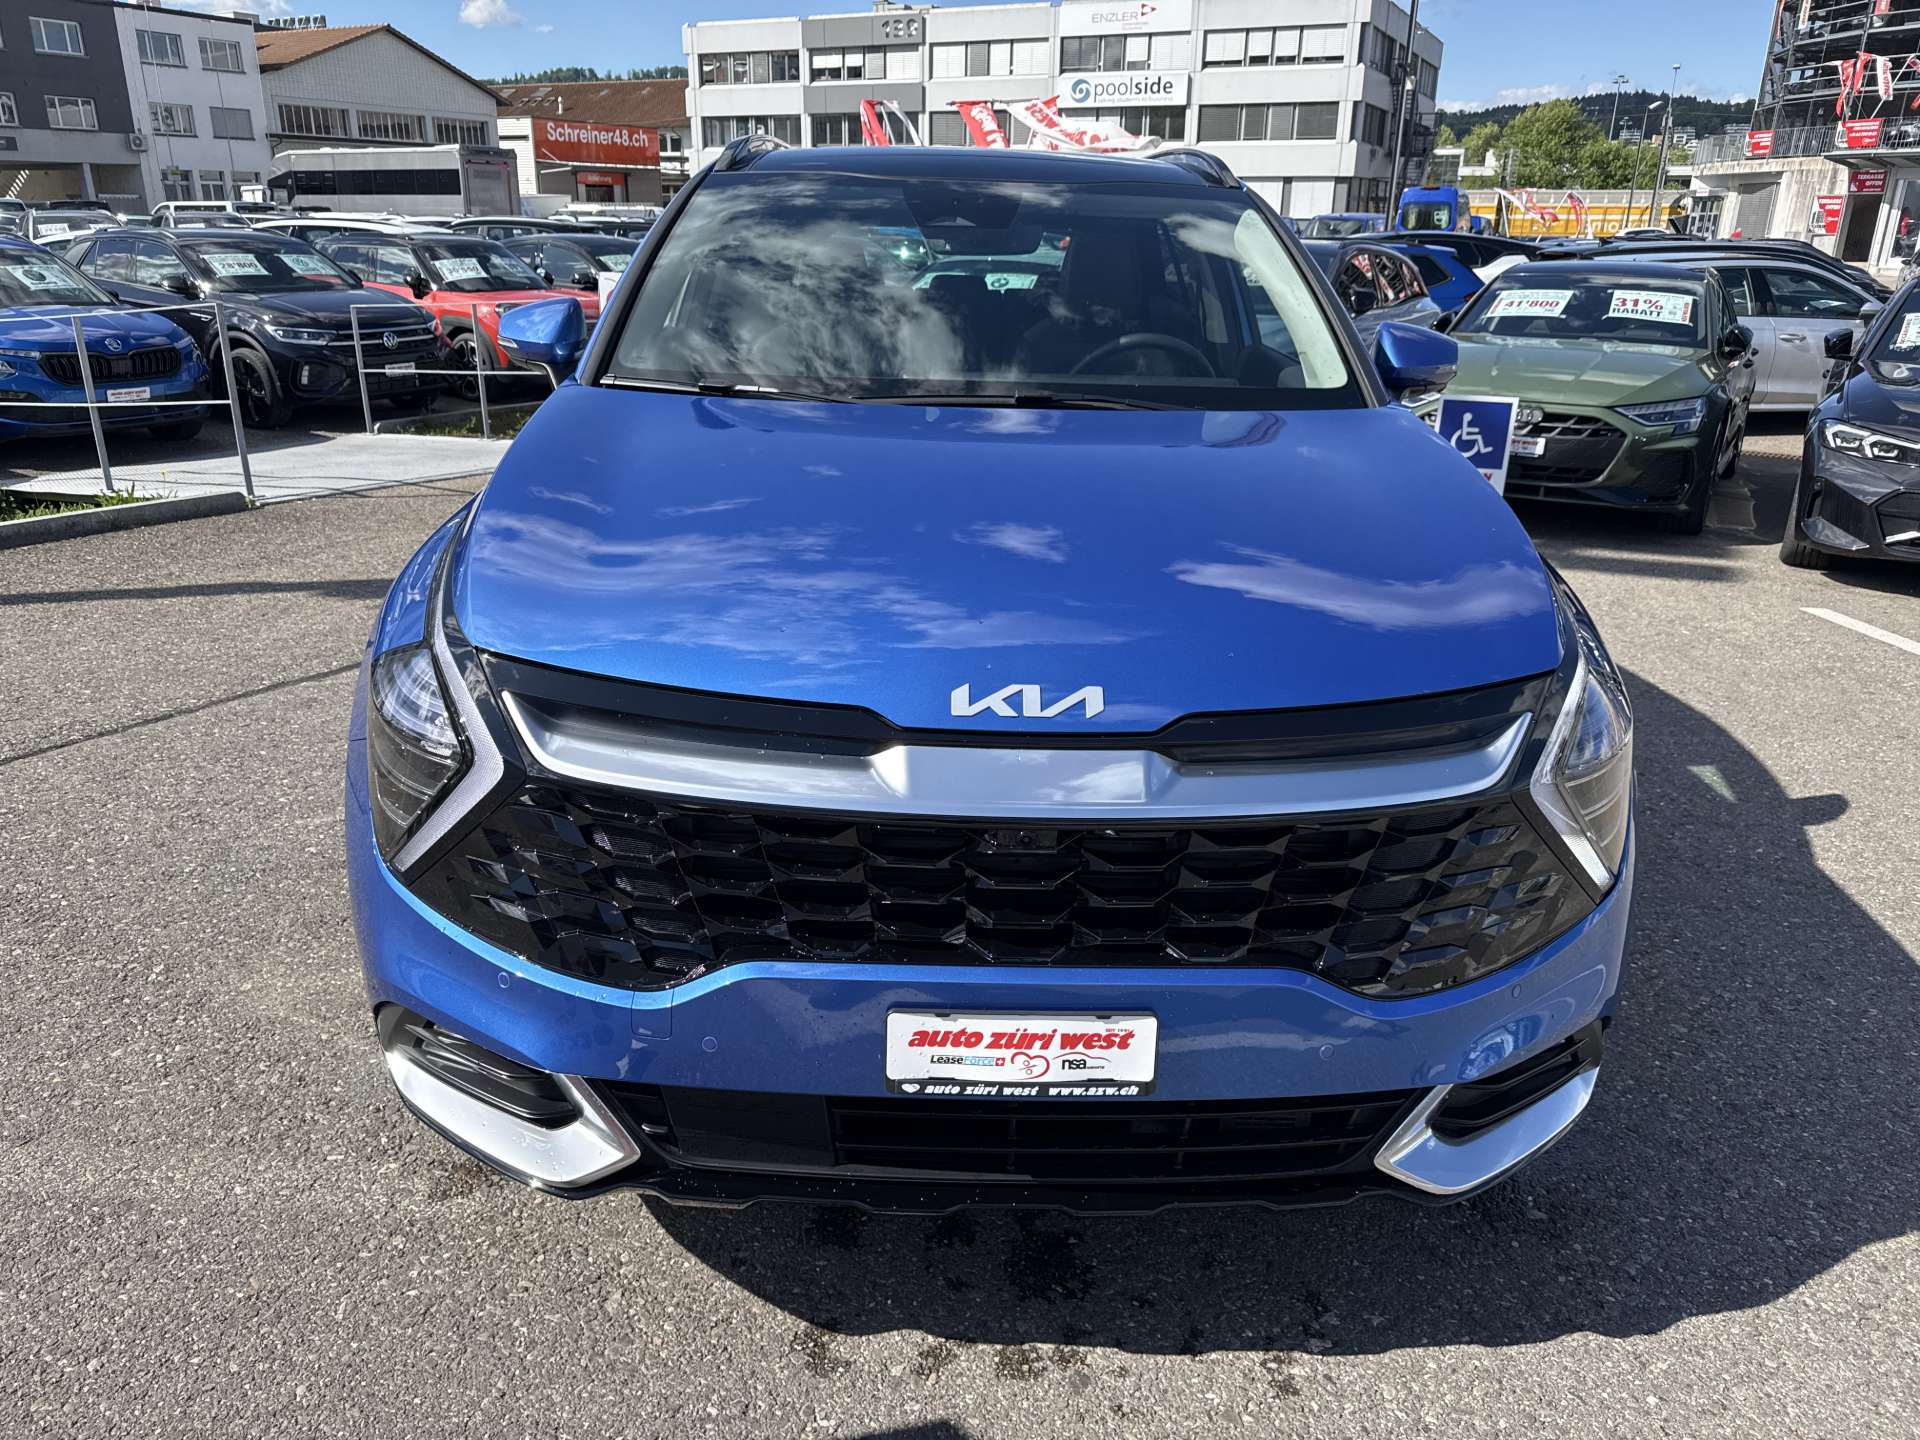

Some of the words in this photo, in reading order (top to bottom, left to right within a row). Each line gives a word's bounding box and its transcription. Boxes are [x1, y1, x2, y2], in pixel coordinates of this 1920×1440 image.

[1092, 11, 1139, 23] ENZLER
[1094, 75, 1174, 103] poolside
[547, 121, 649, 147] Schreiner48.ch
[1504, 300, 1561, 308] 41'800
[1614, 297, 1664, 311] 31%
[1612, 307, 1664, 317] RABATT
[951, 683, 1104, 719] KIA
[908, 1027, 984, 1048] auto
[984, 1028, 1058, 1050] züri
[1060, 1028, 1136, 1050] west
[1061, 1058, 1087, 1070] nsa
[924, 1084, 961, 1094] auto
[963, 1084, 999, 1095] züri
[1002, 1085, 1040, 1096] west
[1048, 1085, 1140, 1096] www.azw.ch
